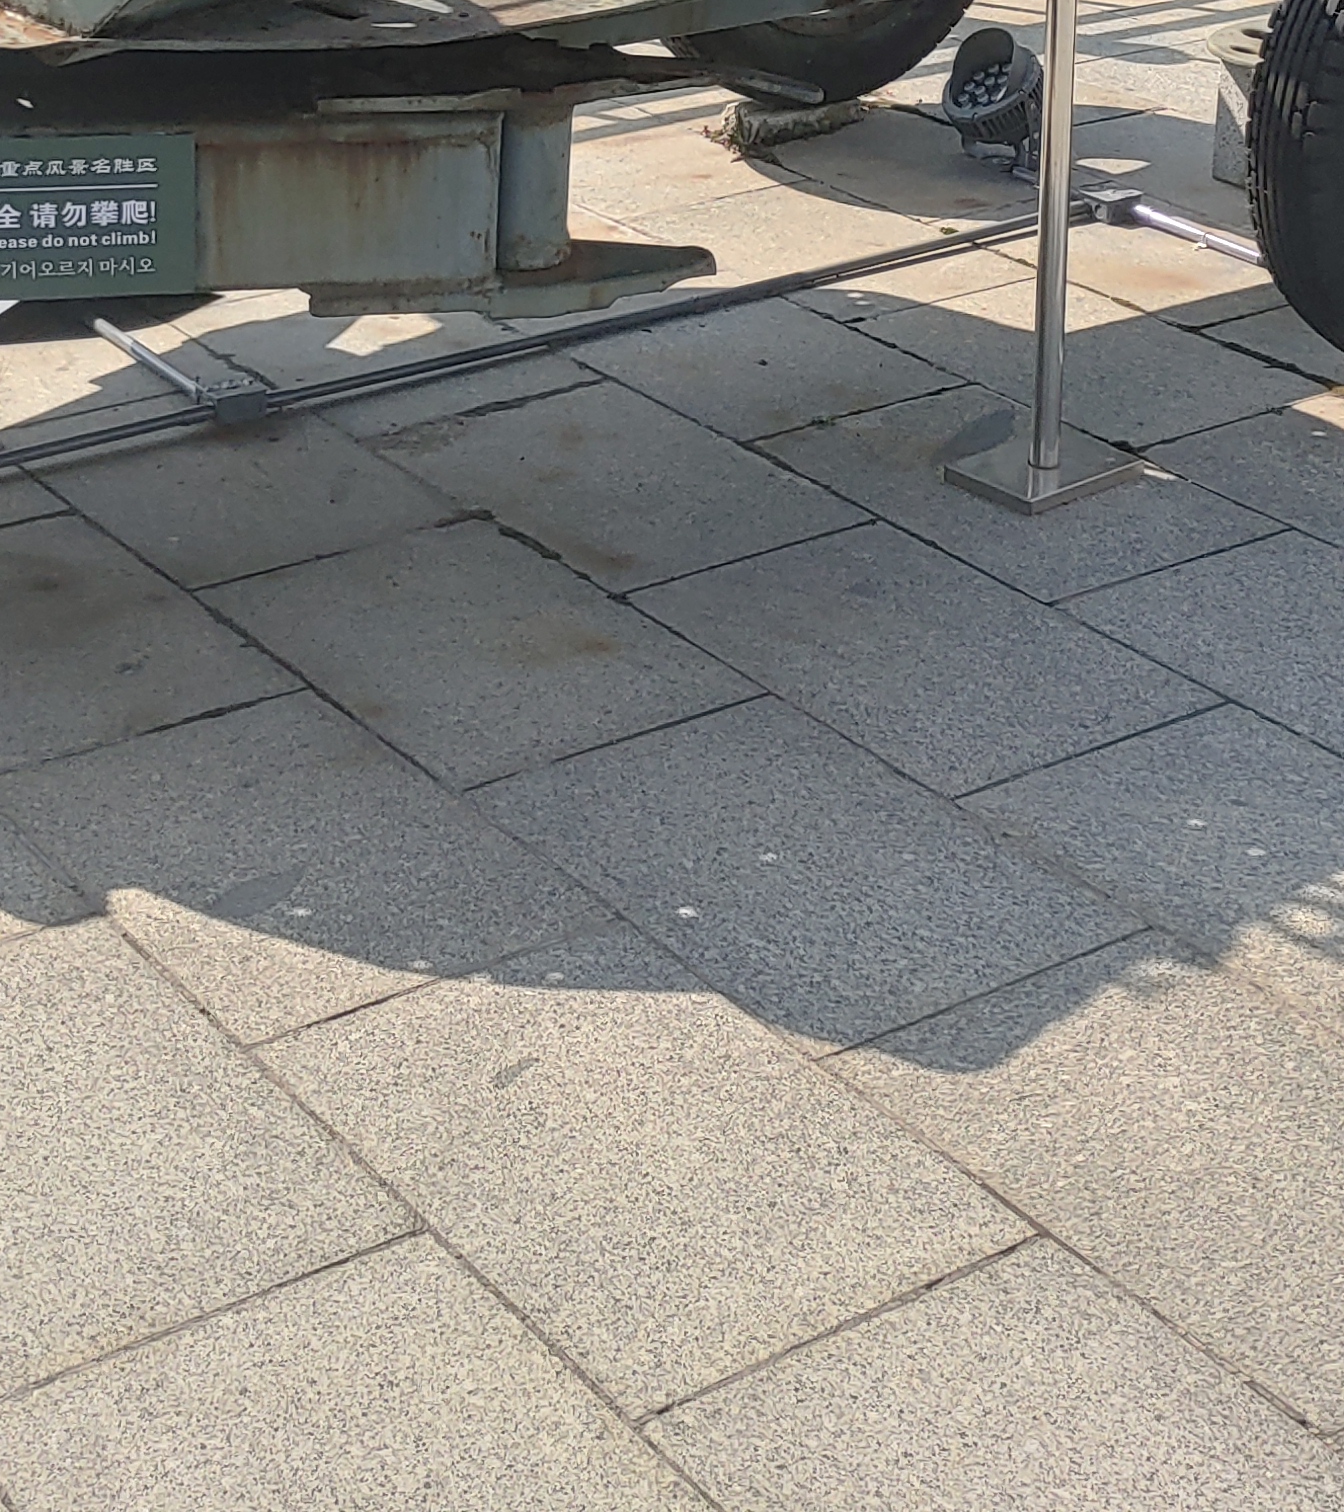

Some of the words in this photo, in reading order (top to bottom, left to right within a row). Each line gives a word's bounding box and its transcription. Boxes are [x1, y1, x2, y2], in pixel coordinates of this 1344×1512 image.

[42, 234, 64, 248] do
[68, 233, 98, 247] not
[101, 229, 156, 246] climb!
[99, 256, 156, 277] 마시오
